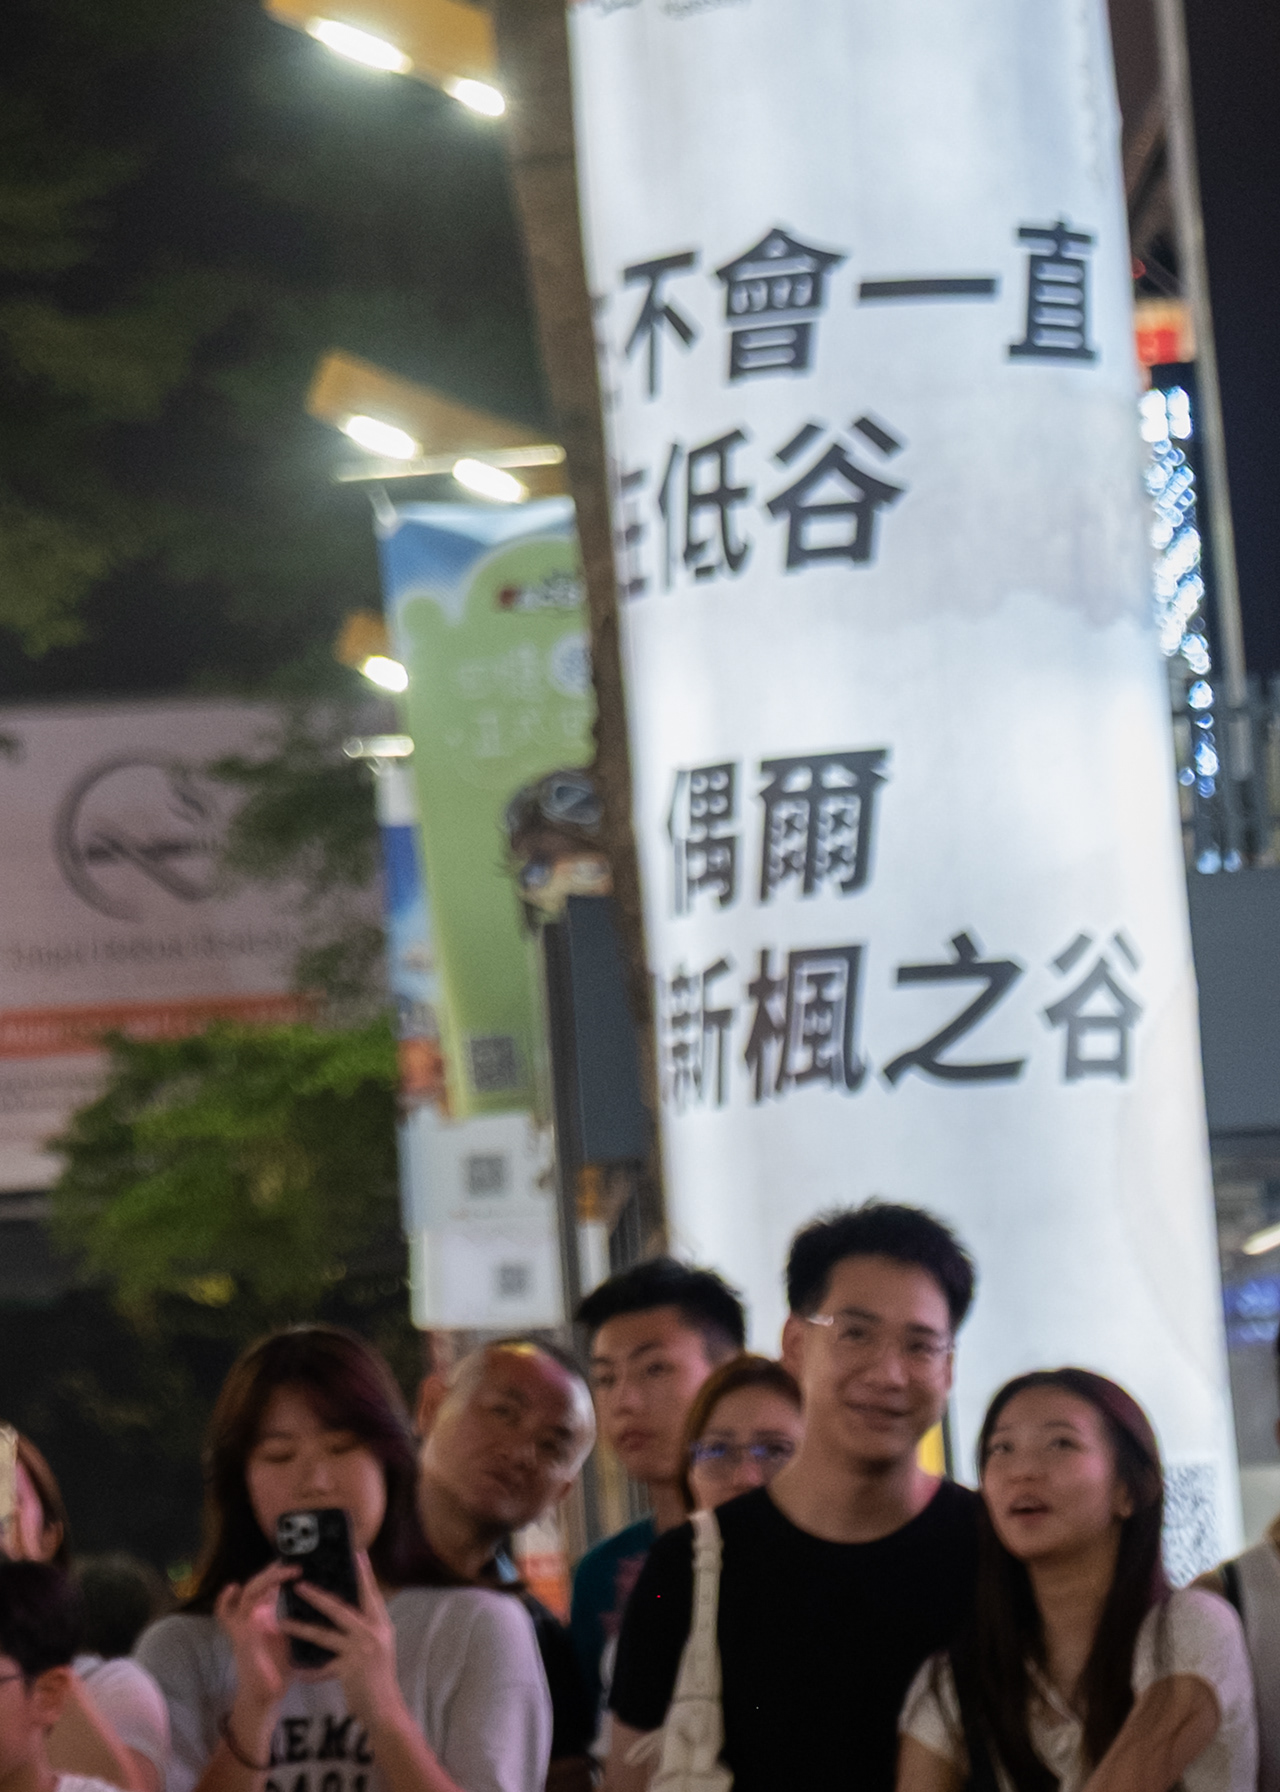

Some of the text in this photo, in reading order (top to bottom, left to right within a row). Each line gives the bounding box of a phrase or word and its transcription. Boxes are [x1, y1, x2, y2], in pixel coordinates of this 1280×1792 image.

[593, 221, 1097, 398] 不會一直
[666, 748, 889, 918] 偶爾
[654, 931, 1144, 1108] 新楓之谷
